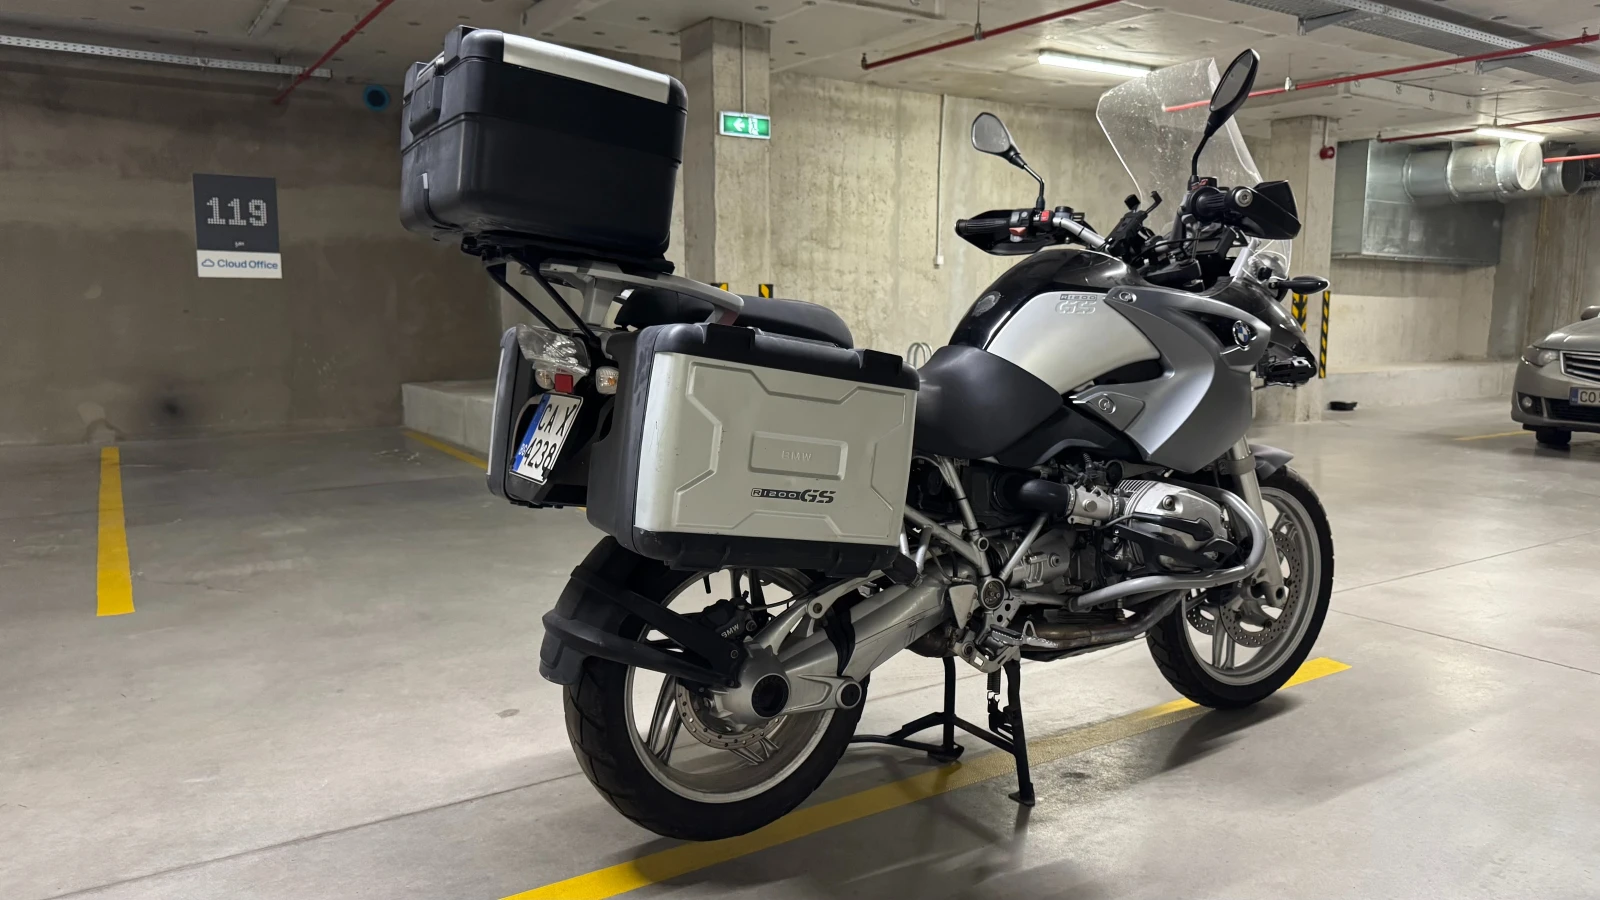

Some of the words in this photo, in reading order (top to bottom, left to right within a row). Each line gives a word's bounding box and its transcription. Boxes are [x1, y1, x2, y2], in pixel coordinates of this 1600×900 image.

[206, 197, 267, 226] 119
[217, 259, 247, 268] Cloud
[249, 260, 278, 270] Office
[1055, 300, 1097, 314] GS
[538, 404, 559, 433] CA
[556, 404, 577, 437] X
[524, 437, 557, 469] 4238
[781, 450, 812, 461] BMW
